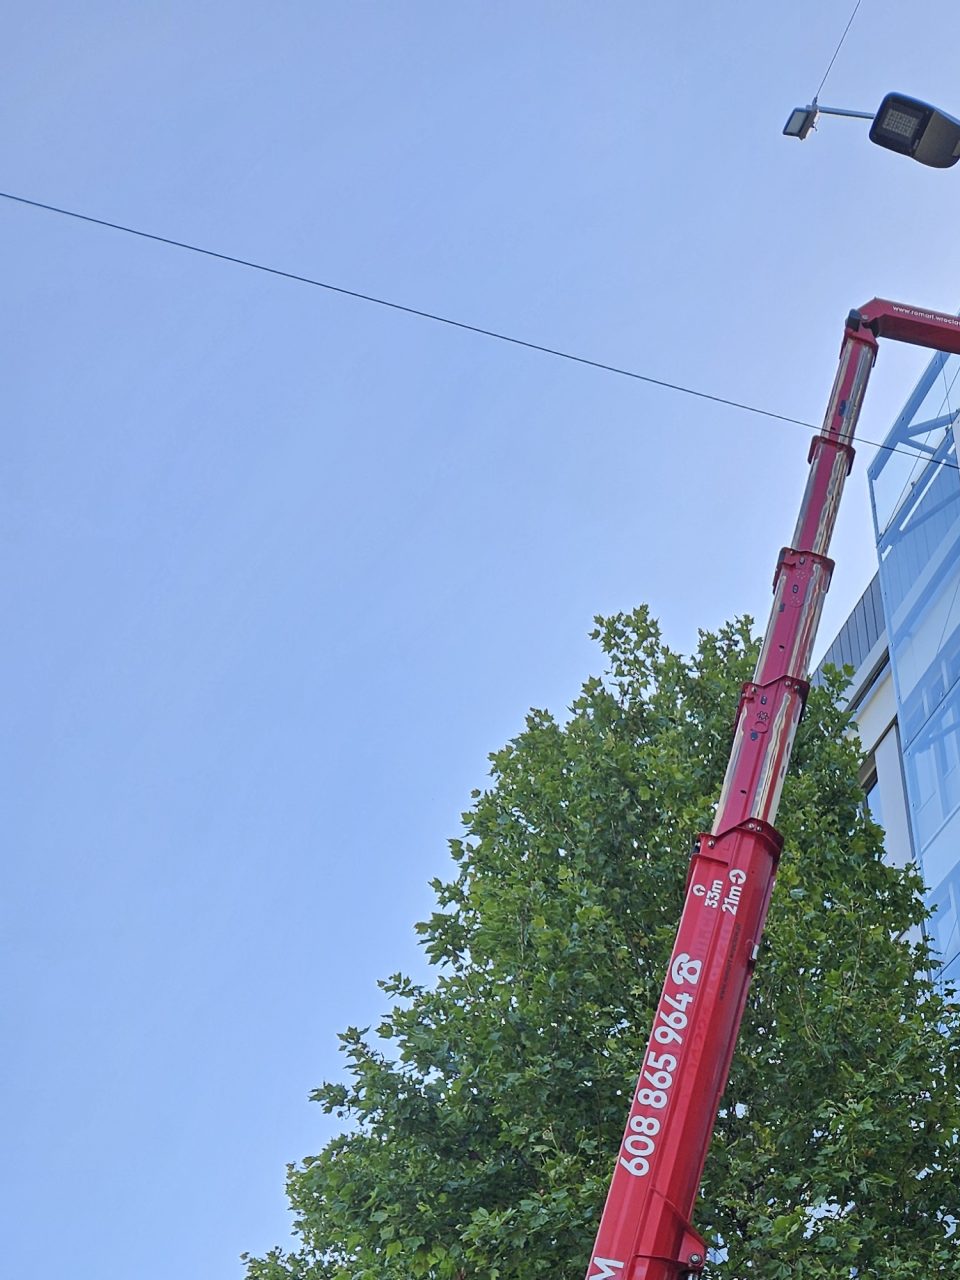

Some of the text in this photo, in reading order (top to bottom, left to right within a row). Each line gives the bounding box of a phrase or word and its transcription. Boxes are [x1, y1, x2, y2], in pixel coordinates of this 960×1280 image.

[704, 880, 723, 908] 33m
[722, 886, 742, 916] 21m
[620, 992, 693, 1177] 608 865 964
